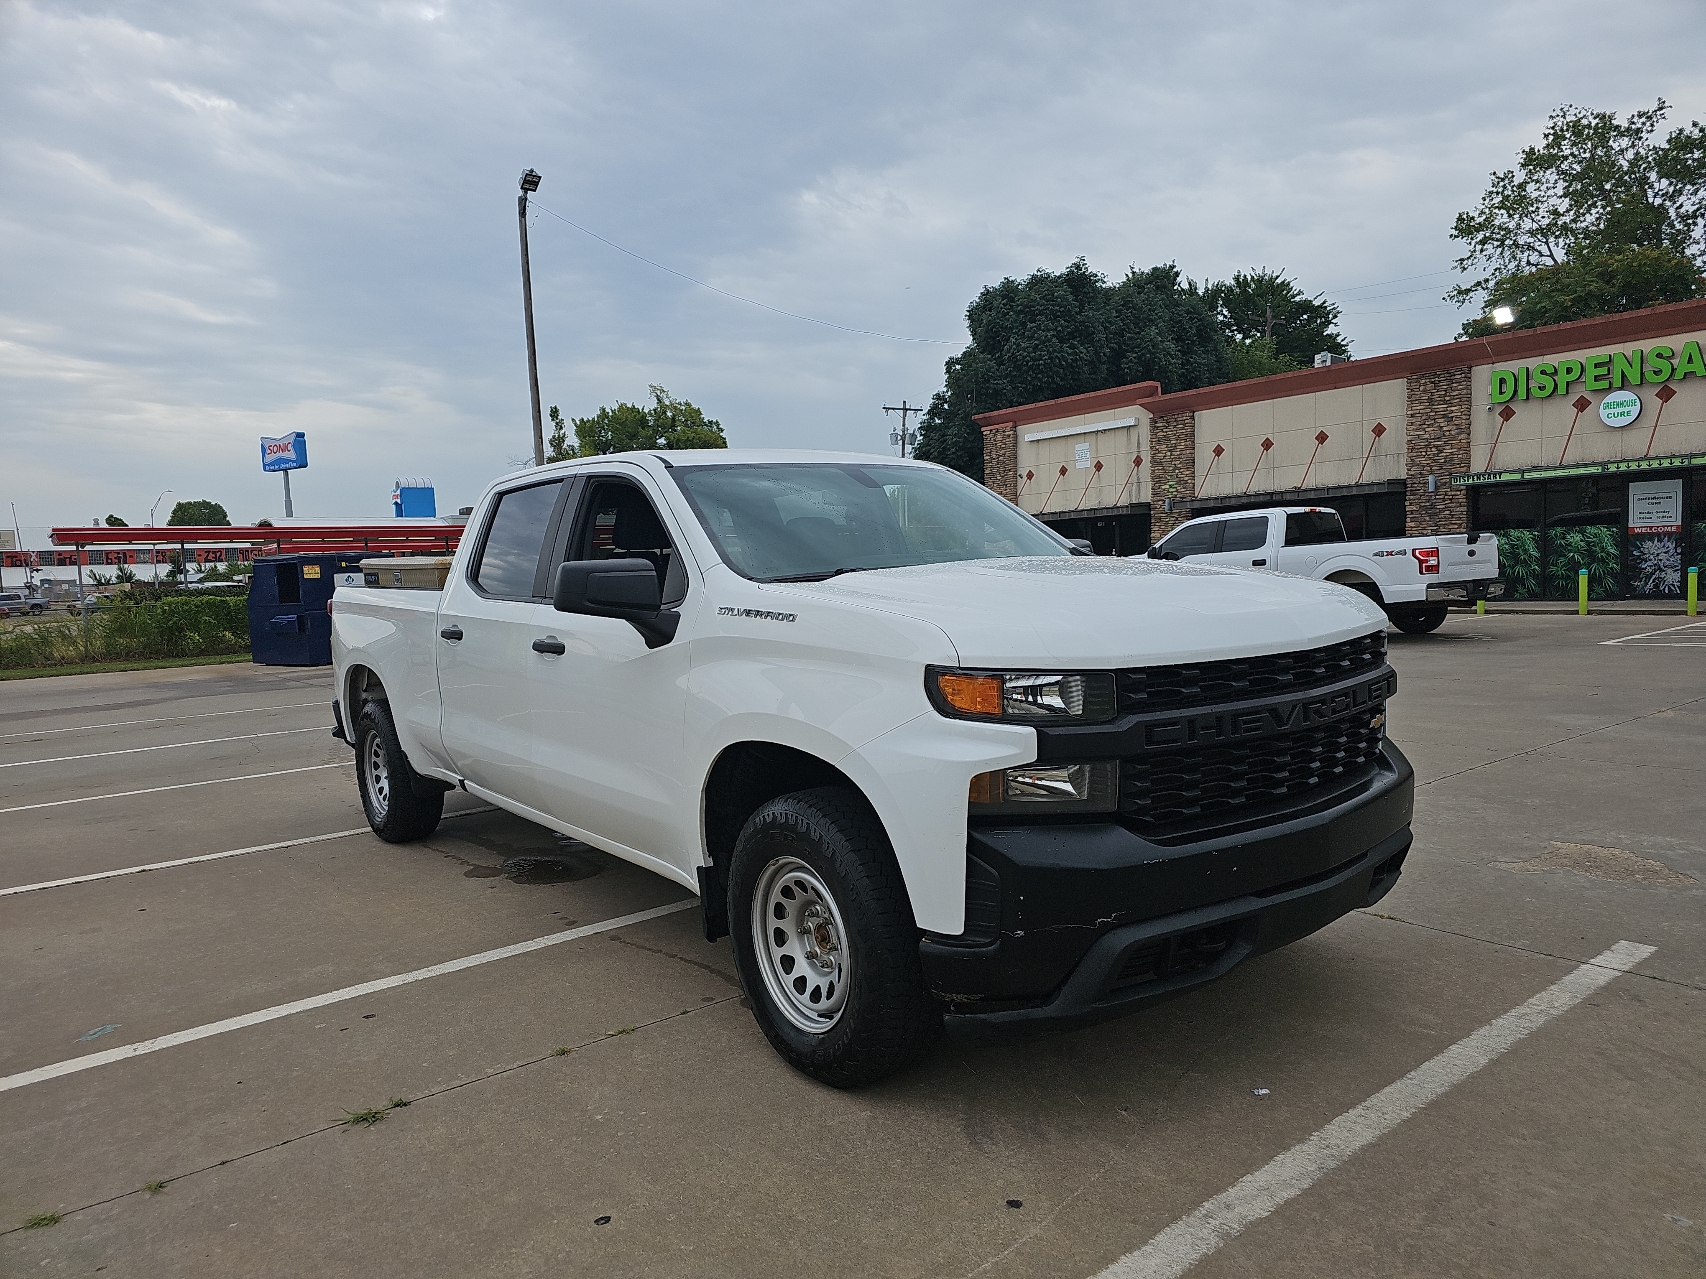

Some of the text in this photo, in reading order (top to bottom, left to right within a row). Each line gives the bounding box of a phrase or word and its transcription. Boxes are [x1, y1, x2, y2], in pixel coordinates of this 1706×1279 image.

[1602, 398, 1637, 411] GREENHOUSE
[1606, 410, 1632, 419] CURE
[267, 442, 292, 455] SONIC
[1453, 473, 1502, 484] DISPENSARY
[717, 606, 798, 622] SILVERADO
[1144, 674, 1395, 749] CHEVROLET
